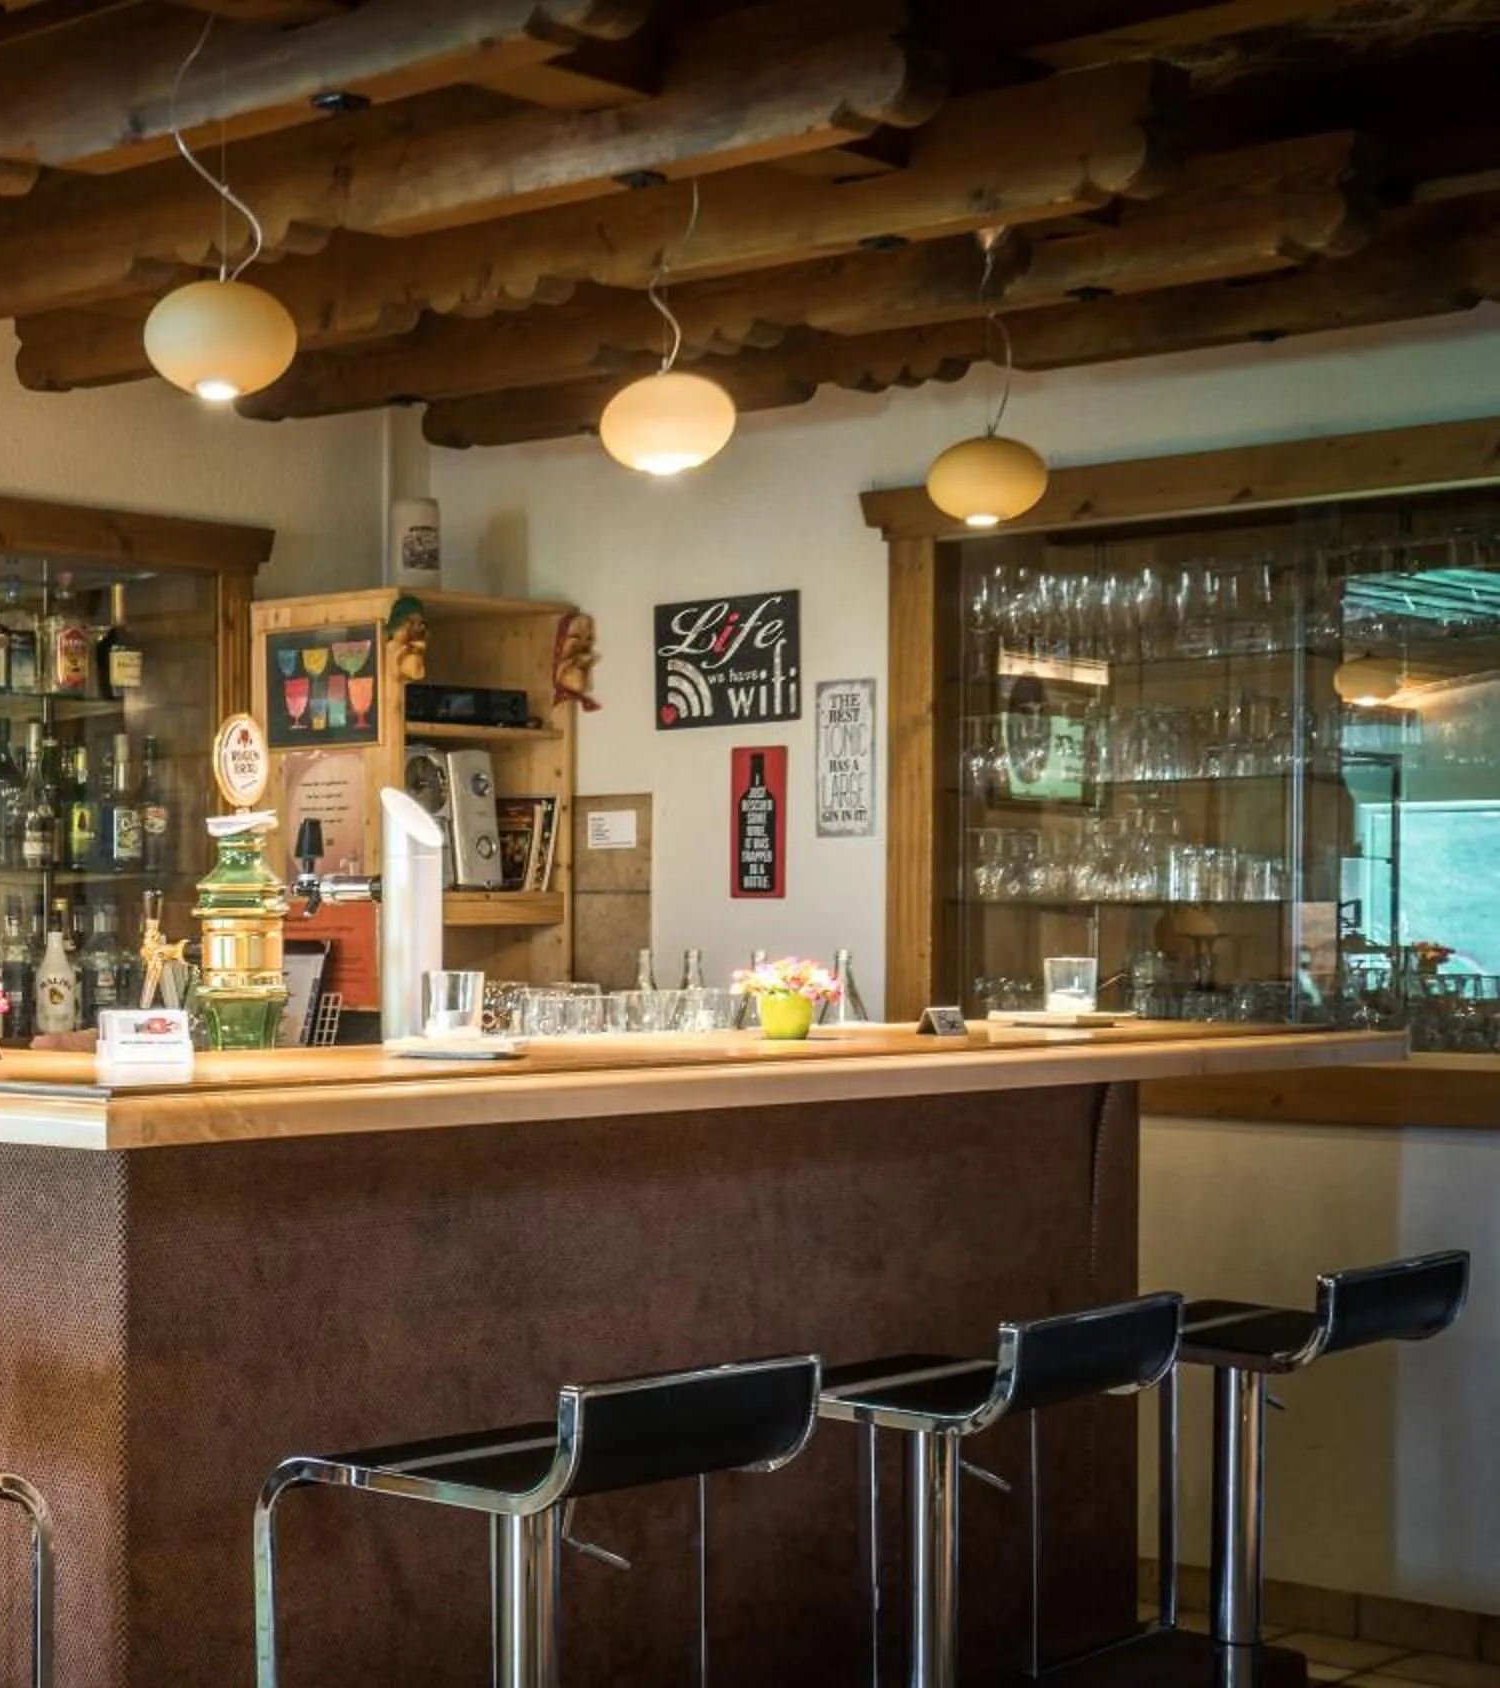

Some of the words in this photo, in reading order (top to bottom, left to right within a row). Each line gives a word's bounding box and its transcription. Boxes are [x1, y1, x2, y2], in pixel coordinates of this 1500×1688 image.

[657, 596, 785, 669] Life
[829, 693, 861, 708] THE
[829, 708, 860, 723] BEST
[829, 760, 850, 773] HAS
[852, 760, 859, 771] A
[821, 810, 839, 822] GIN
[841, 810, 850, 821] IN
